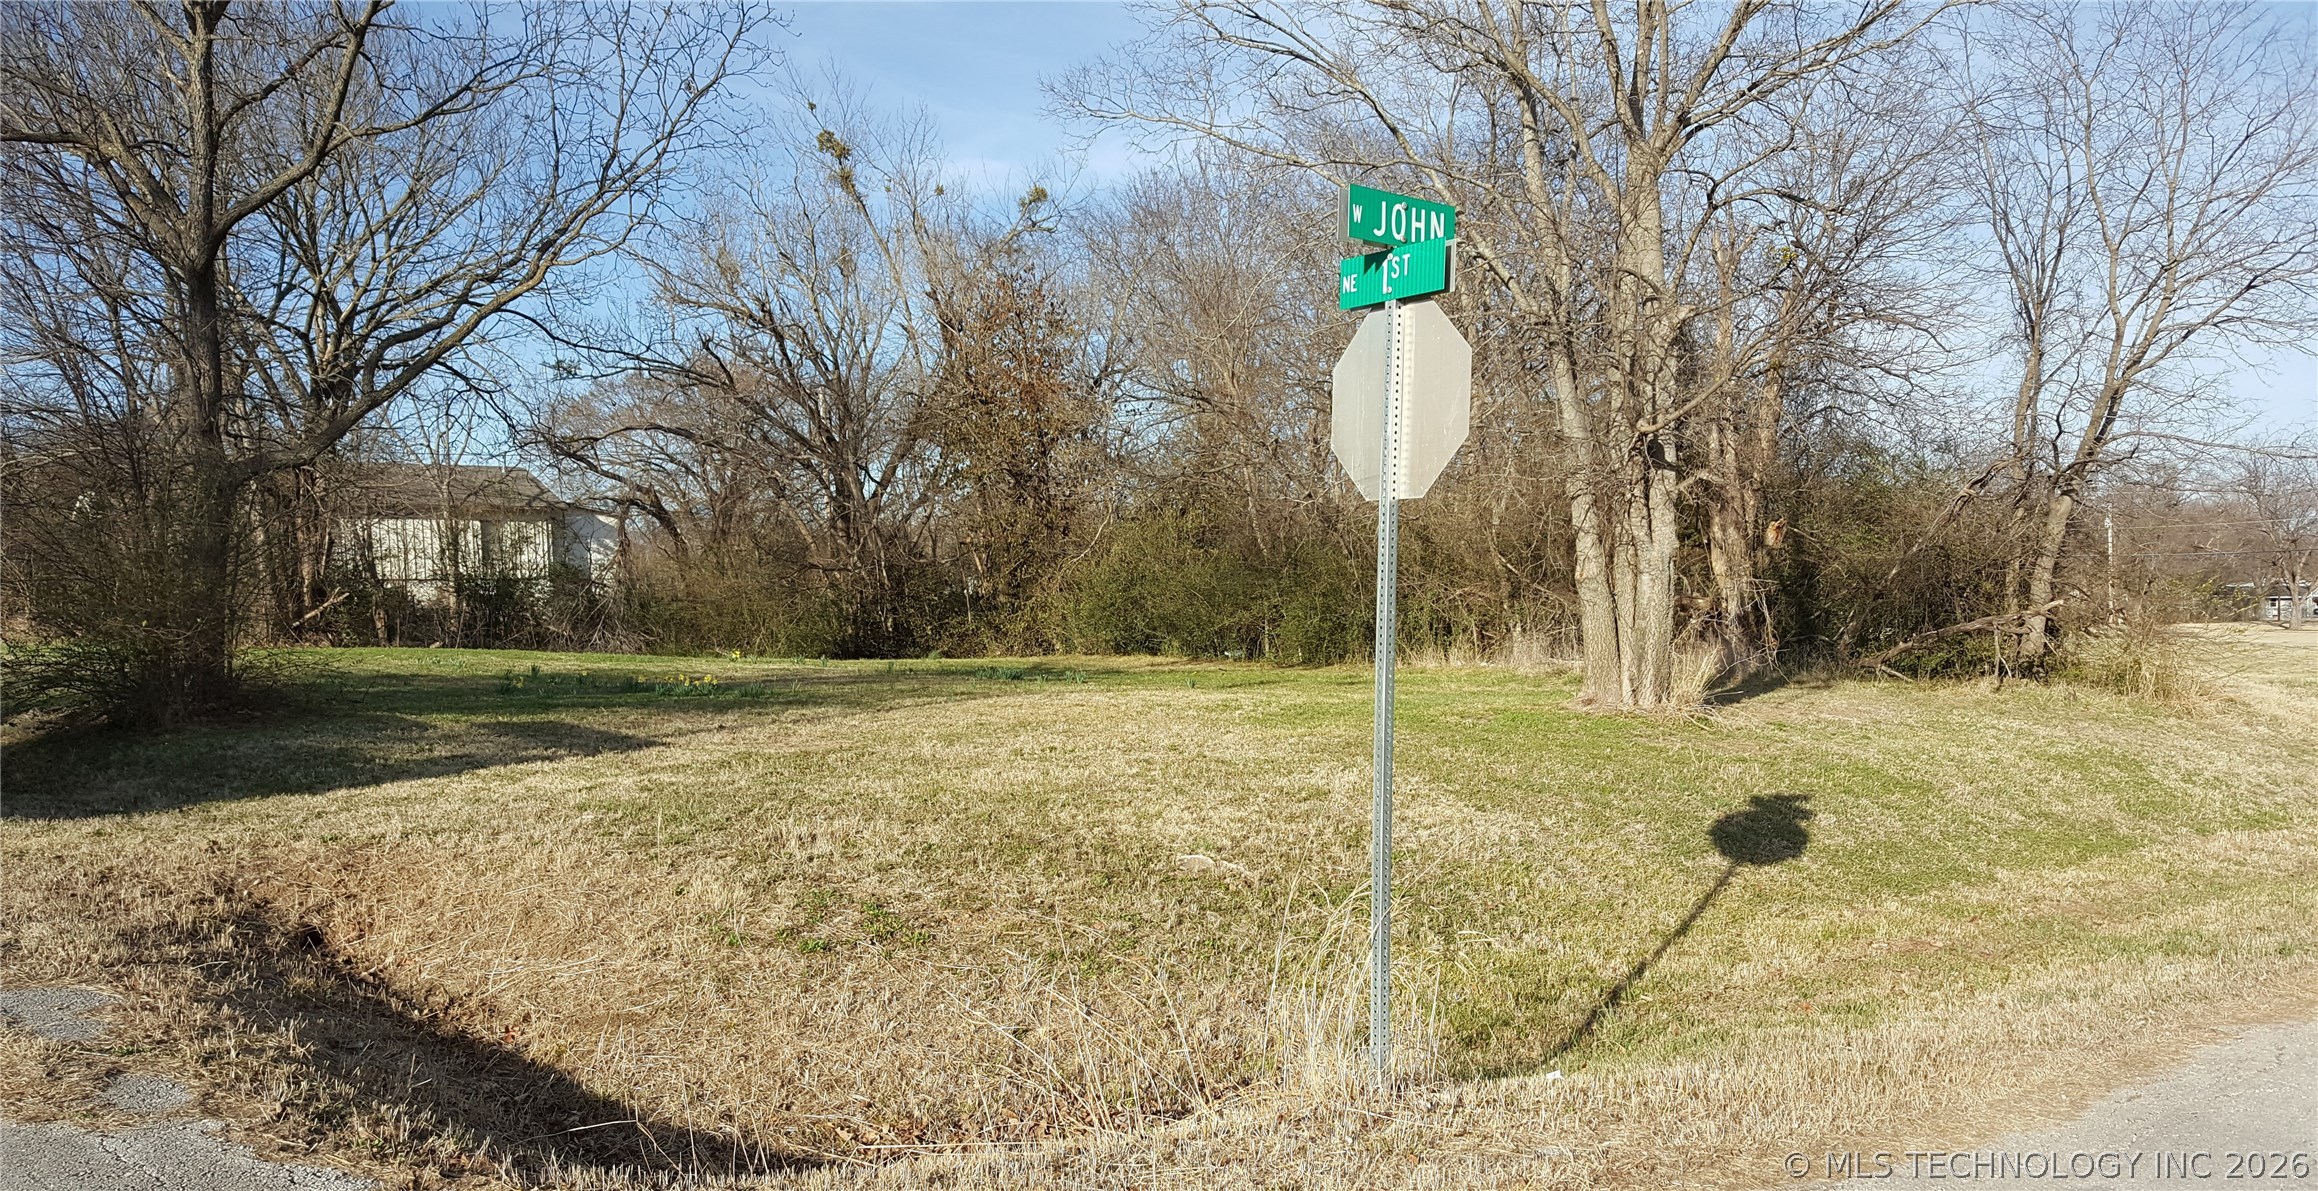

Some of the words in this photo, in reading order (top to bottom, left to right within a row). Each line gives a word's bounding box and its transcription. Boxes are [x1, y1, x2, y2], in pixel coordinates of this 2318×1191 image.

[1352, 203, 1363, 224] W
[1373, 201, 1445, 243] JOHN
[1342, 273, 1358, 294] NE
[1382, 253, 1411, 295] 1ST
